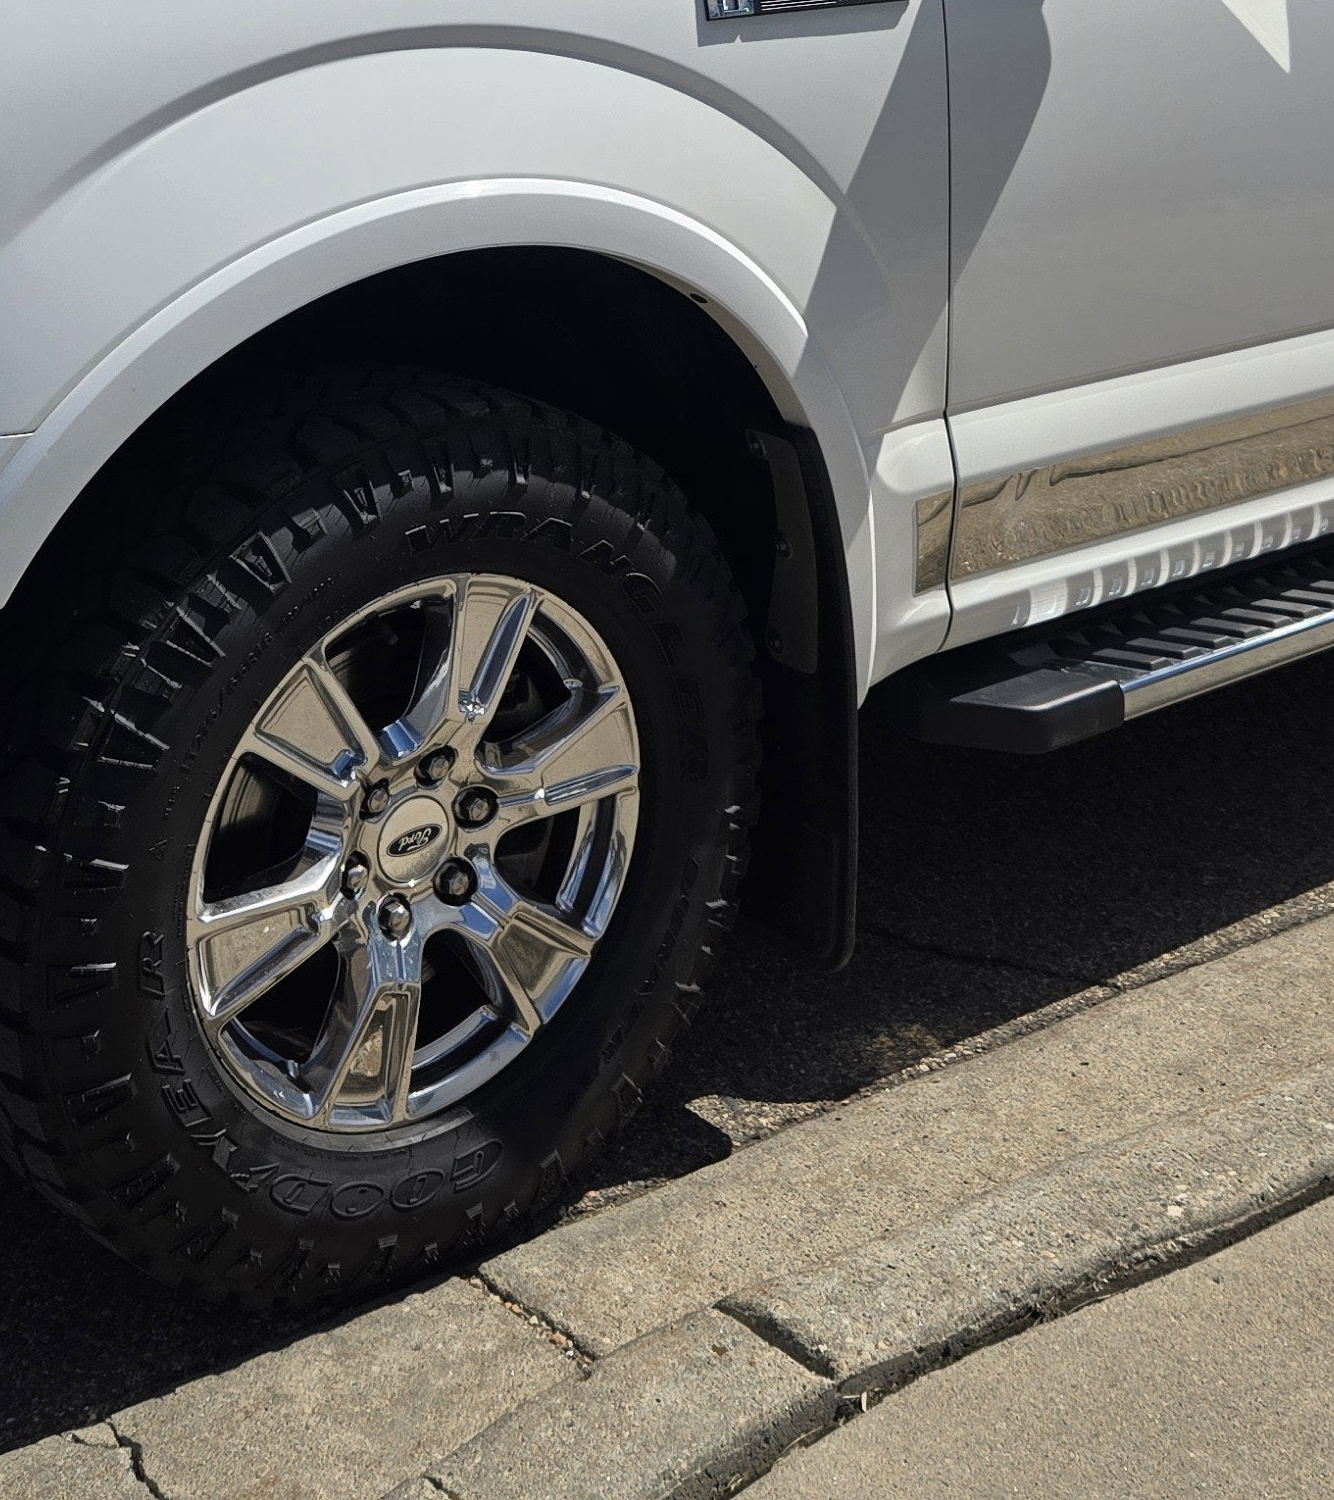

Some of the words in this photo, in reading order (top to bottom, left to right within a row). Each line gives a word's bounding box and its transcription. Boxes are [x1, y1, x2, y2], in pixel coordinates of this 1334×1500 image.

[403, 508, 711, 780] WRANGLER
[394, 825, 435, 854] Ford
[138, 928, 506, 1220] GOODYEAR
